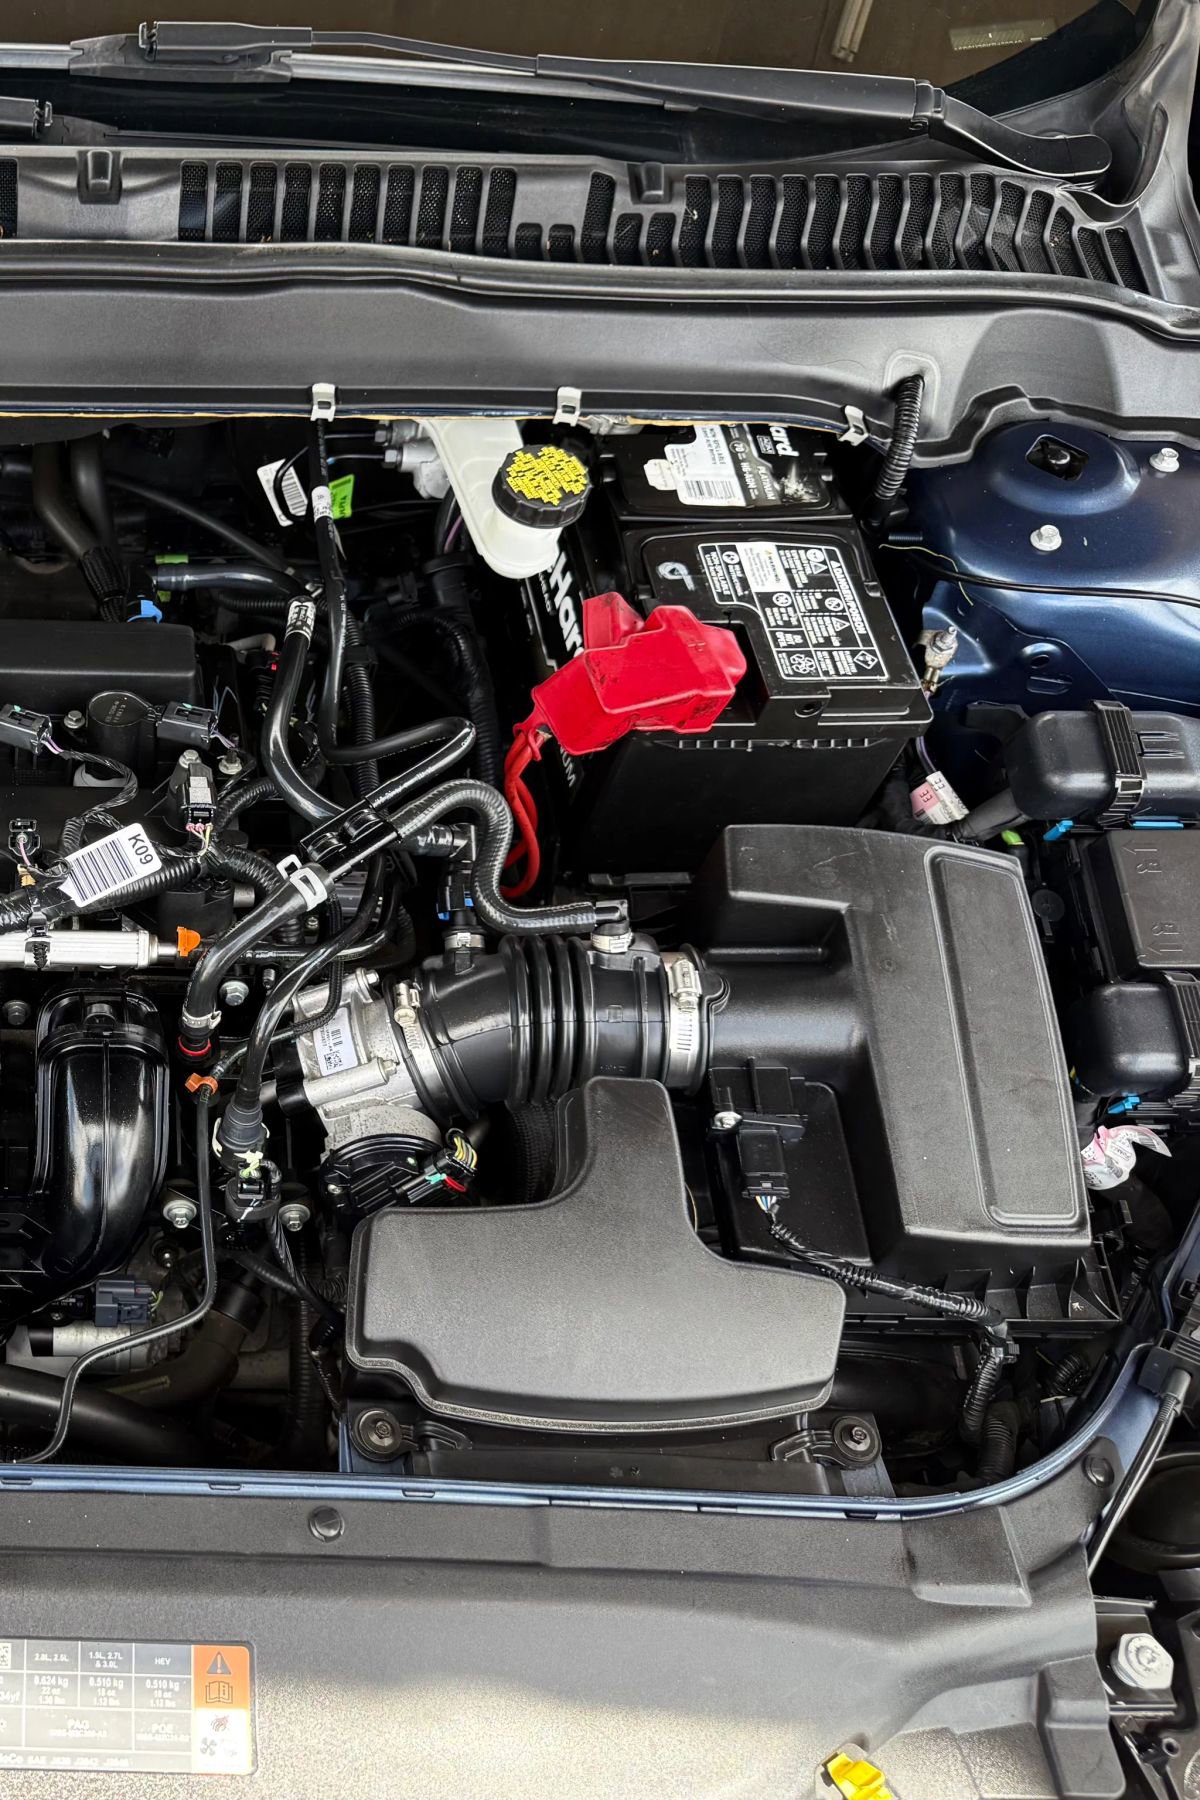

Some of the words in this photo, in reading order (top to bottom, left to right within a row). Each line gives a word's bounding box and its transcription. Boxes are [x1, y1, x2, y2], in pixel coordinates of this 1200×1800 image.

[756, 465, 775, 500] PLATINUM
[709, 551, 730, 595] NON-SPILLABLE
[832, 568, 866, 633] DANGER/POISON
[127, 833, 154, 865] K09
[107, 1652, 123, 1660] 2.7L
[154, 1657, 171, 1666] HEV
[58, 1676, 69, 1688] kg
